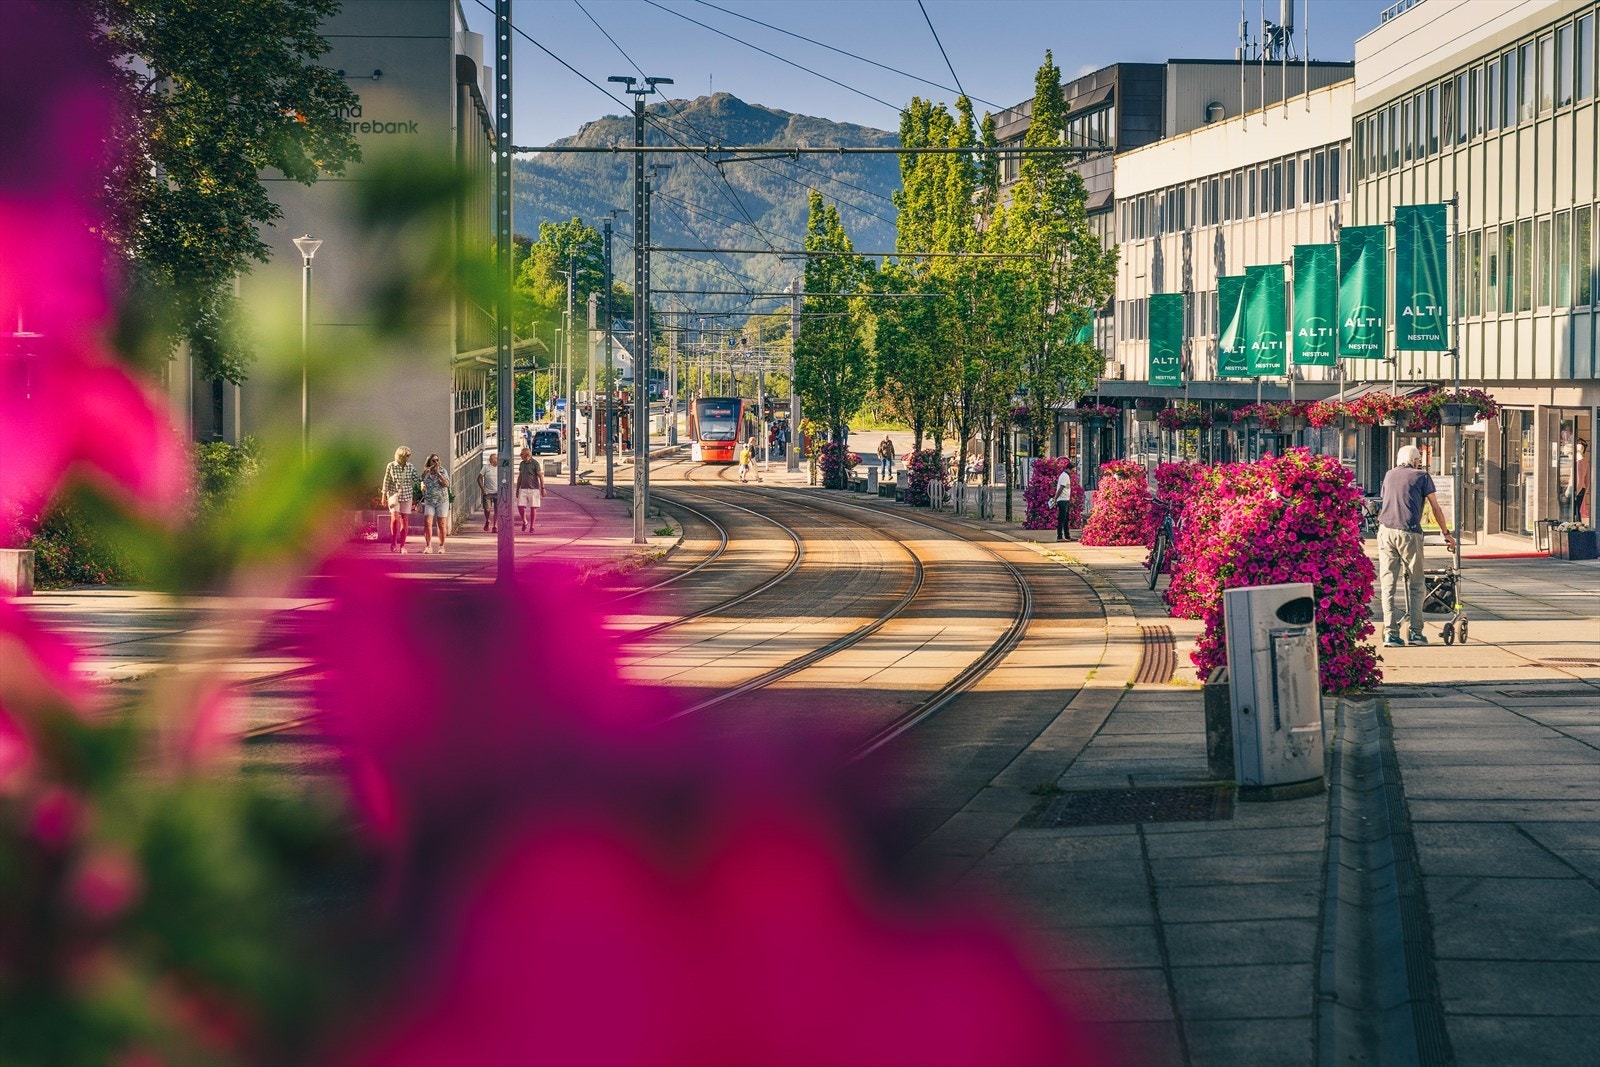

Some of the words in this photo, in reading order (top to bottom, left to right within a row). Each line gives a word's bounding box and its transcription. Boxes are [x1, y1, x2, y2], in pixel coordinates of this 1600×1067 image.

[329, 105, 363, 118] ana
[1402, 306, 1442, 317] ALTI
[1344, 318, 1382, 328] ALTI
[1298, 328, 1333, 337] ALTI
[1223, 346, 1246, 354] ALT
[1251, 341, 1283, 350] ALTI
[1152, 357, 1179, 365] ALTI
